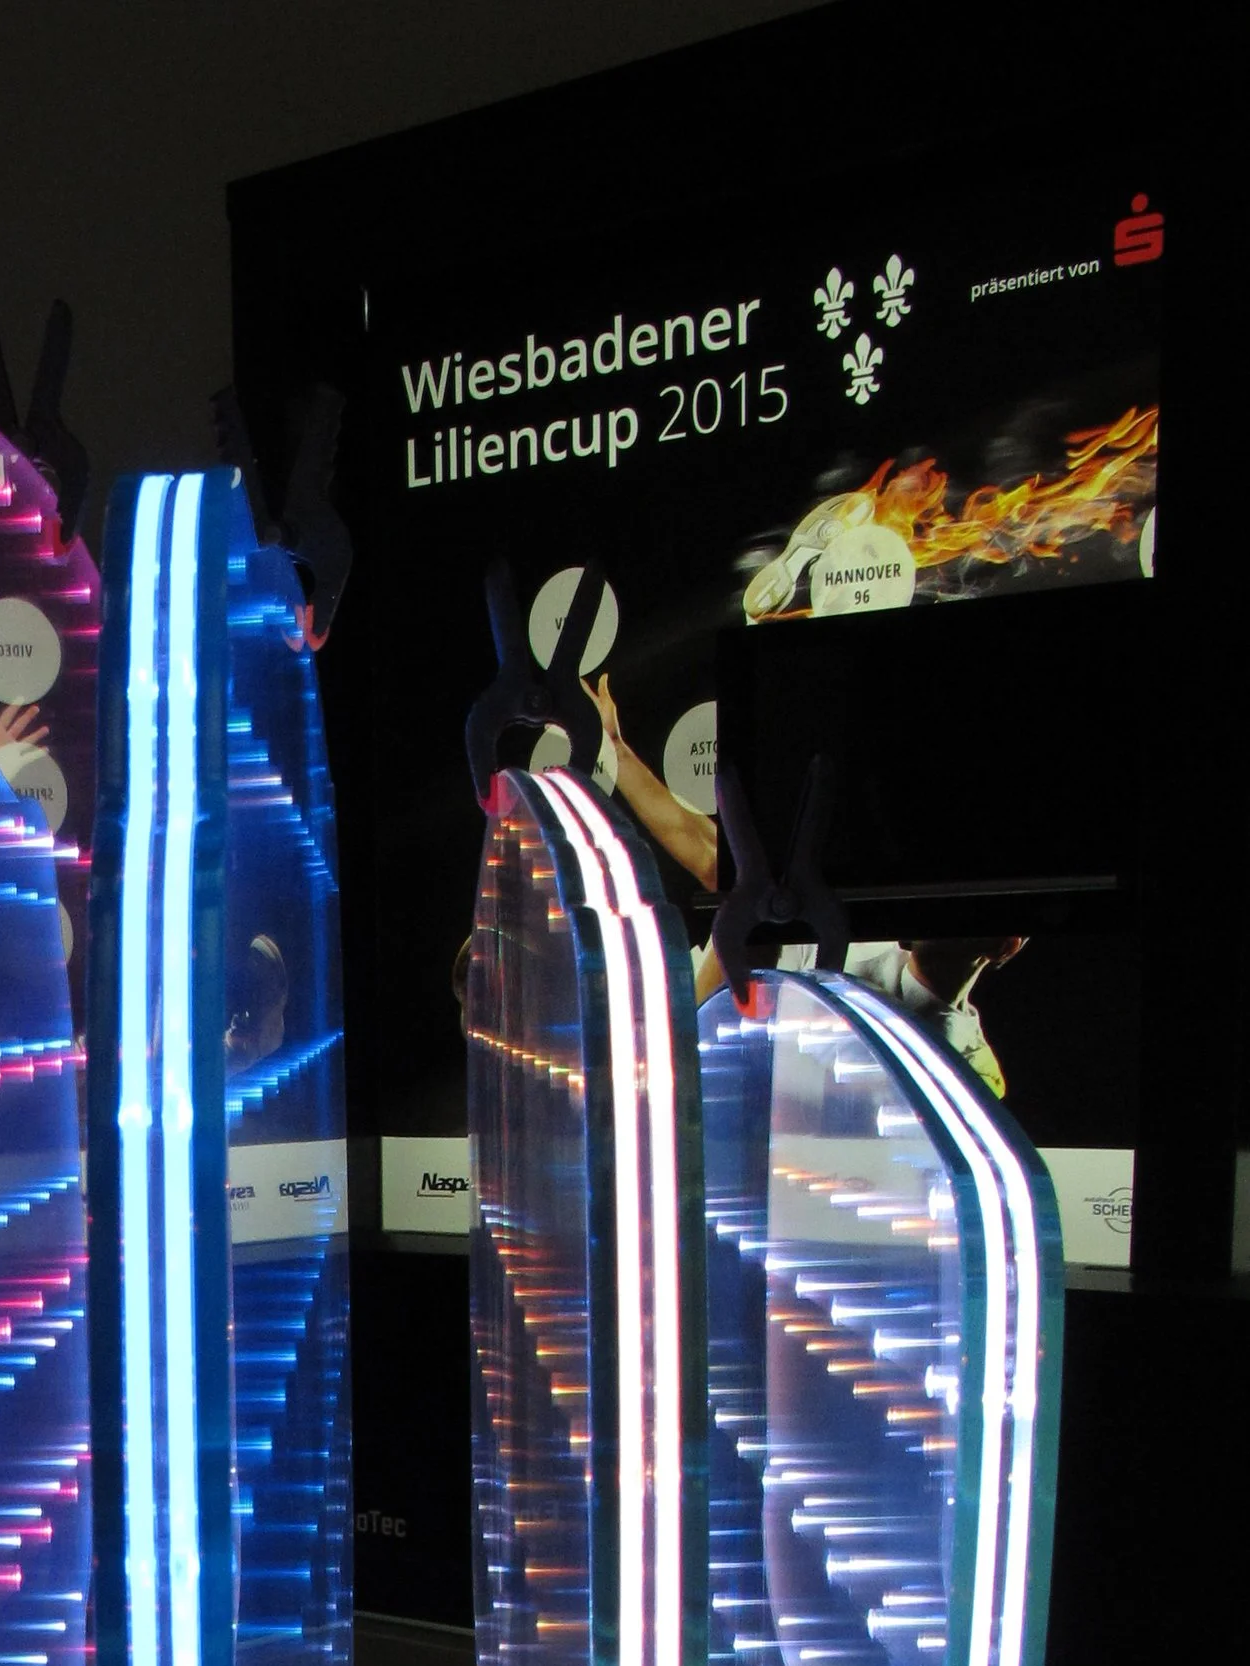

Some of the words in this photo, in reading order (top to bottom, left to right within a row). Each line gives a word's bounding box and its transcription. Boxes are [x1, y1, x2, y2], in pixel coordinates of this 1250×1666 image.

[970, 265, 1065, 302] präsentiert
[1067, 258, 1100, 279] von
[401, 298, 761, 414] Wiesbadener
[406, 404, 639, 489] Liliencup
[657, 364, 789, 442] 2015
[825, 563, 902, 586] HANNOVER
[854, 588, 870, 605] 96
